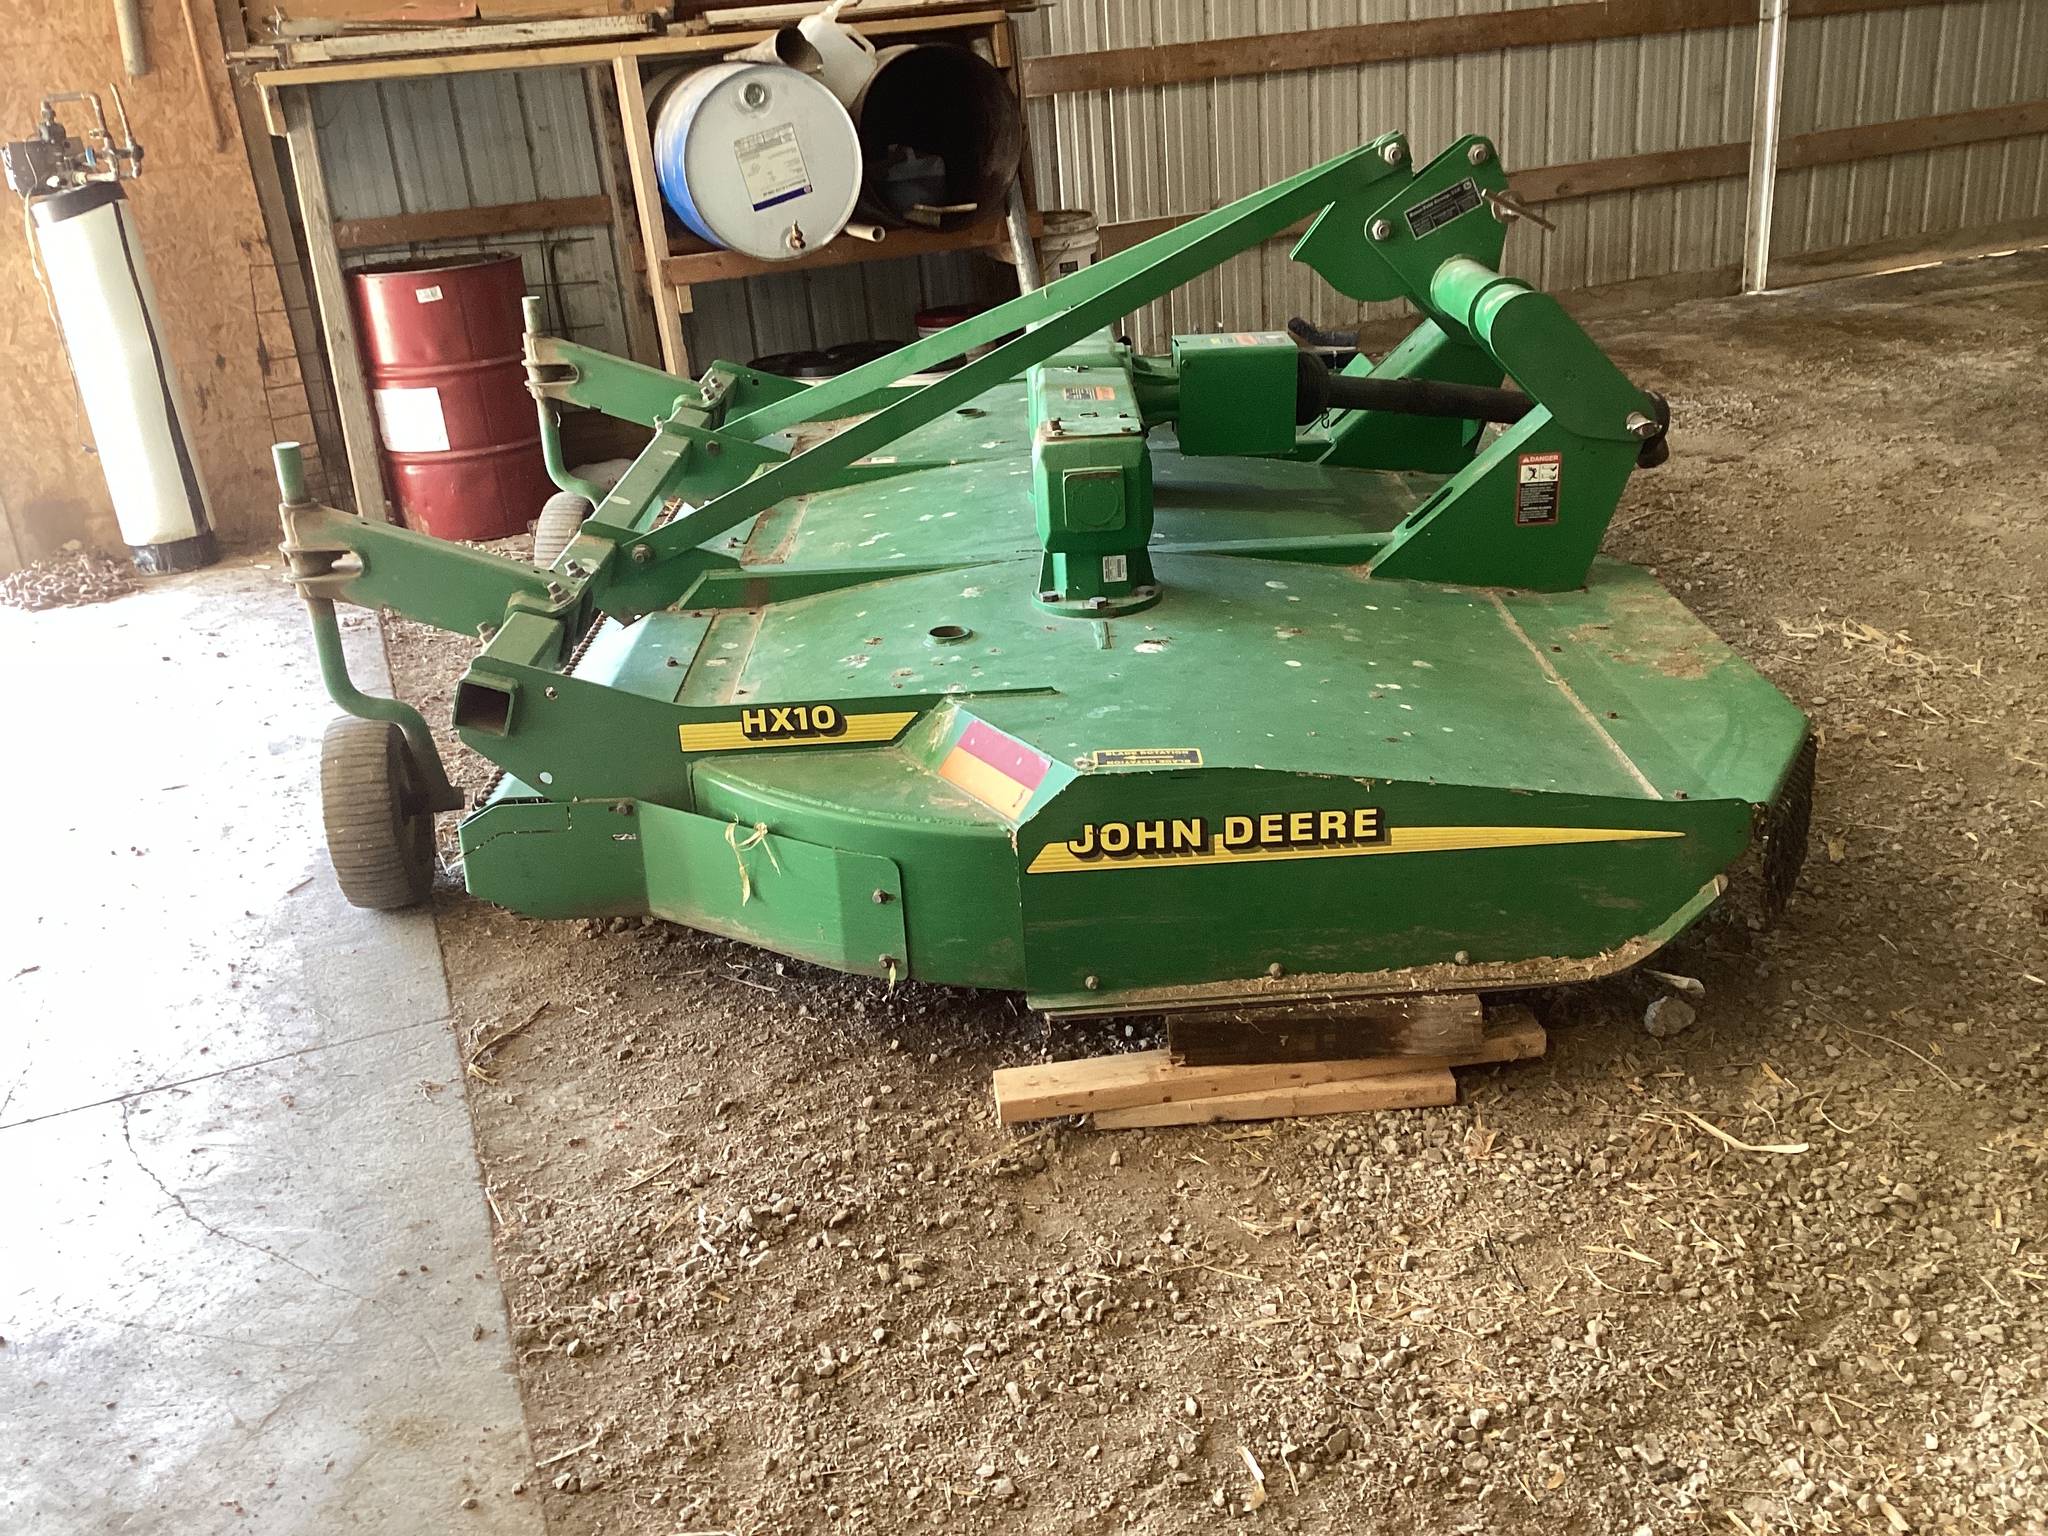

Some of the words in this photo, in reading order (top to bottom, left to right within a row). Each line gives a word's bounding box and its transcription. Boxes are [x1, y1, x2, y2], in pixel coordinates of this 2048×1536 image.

[741, 704, 838, 736] HX10
[1068, 817, 1203, 856] JOHN
[1223, 807, 1380, 846] DEERE
